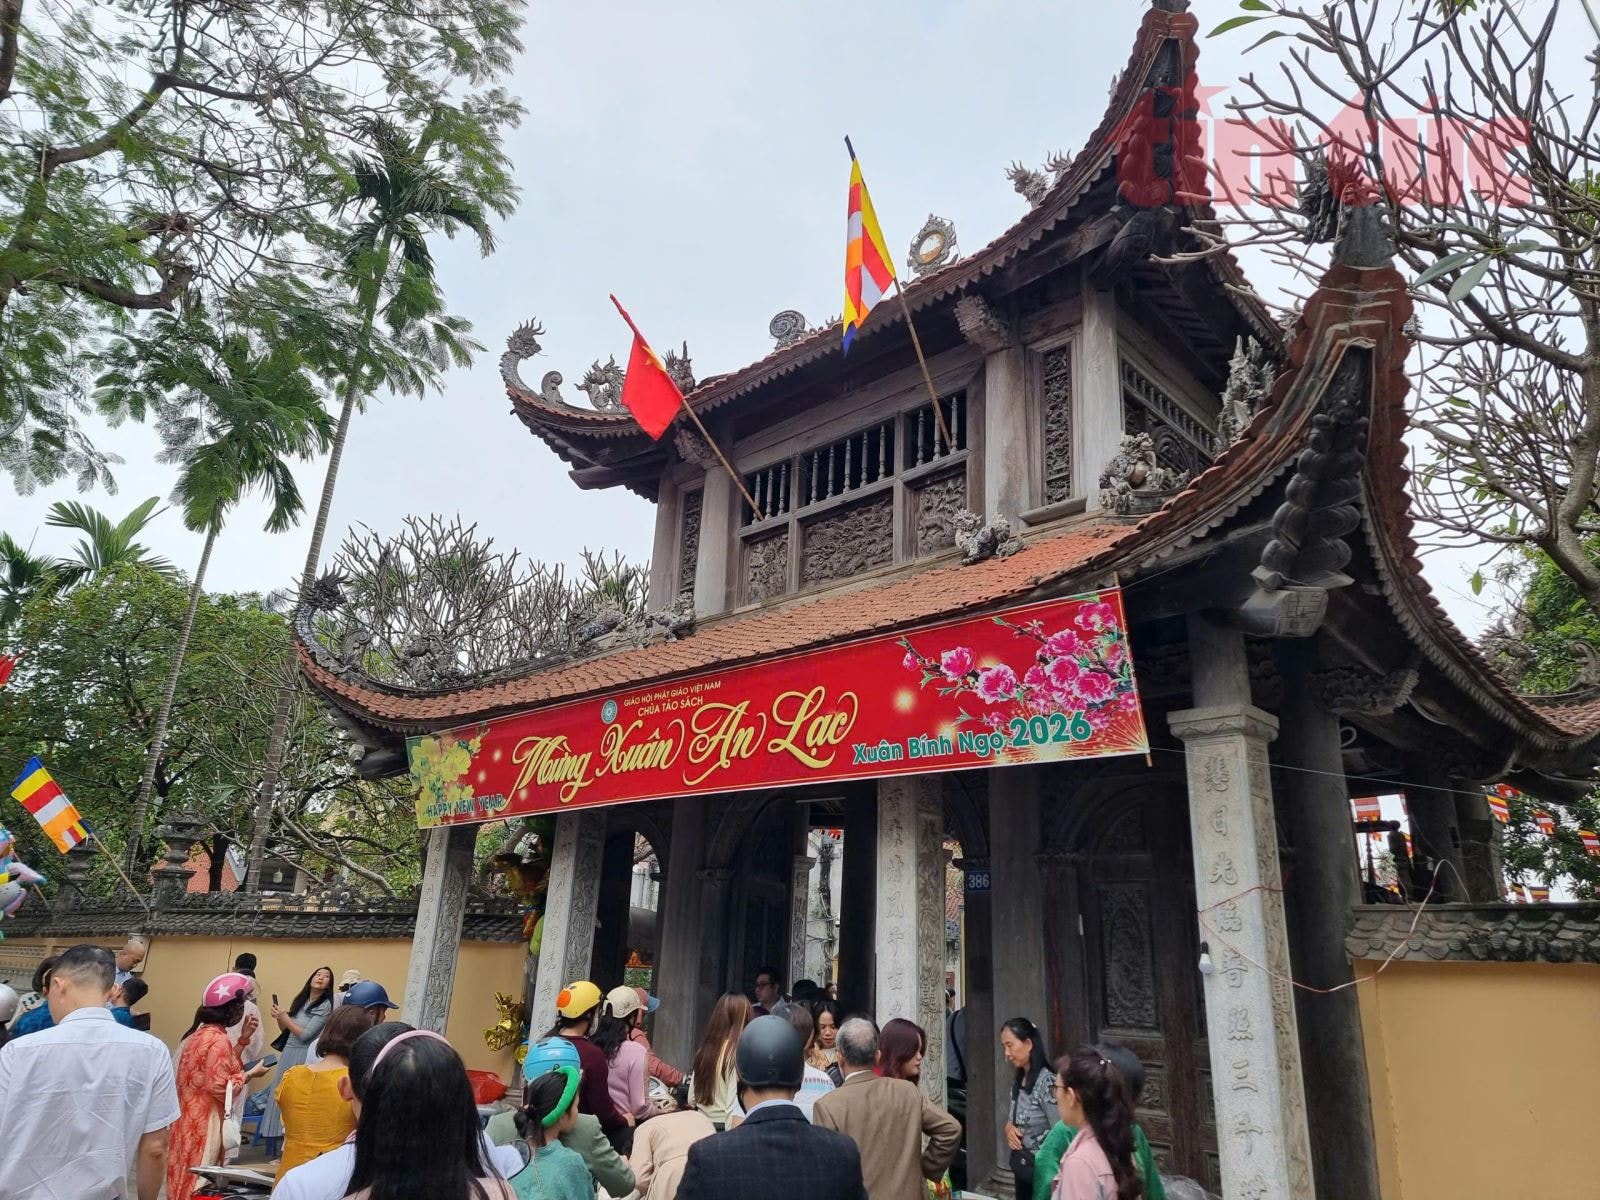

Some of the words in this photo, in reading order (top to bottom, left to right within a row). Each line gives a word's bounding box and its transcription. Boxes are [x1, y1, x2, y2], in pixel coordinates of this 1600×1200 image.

[624, 696, 640, 707] GIÁO
[642, 693, 653, 704] HỘI
[671, 686, 688, 697] GIÁO
[690, 683, 704, 694] VIỆT
[704, 680, 721, 690] NAM
[638, 702, 661, 717] CHÙA
[680, 695, 704, 709] SÁCH
[596, 719, 685, 777] Xuân
[683, 700, 767, 786] An
[768, 685, 858, 769] Lạc
[852, 739, 903, 765] Xuân
[908, 732, 952, 758] Bính
[959, 727, 1004, 759] Ngọ
[1010, 711, 1091, 747] 2026
[427, 802, 452, 818] HAPPY
[456, 797, 475, 814] NEW
[478, 793, 504, 811] YEAR
[968, 873, 990, 889] 386
